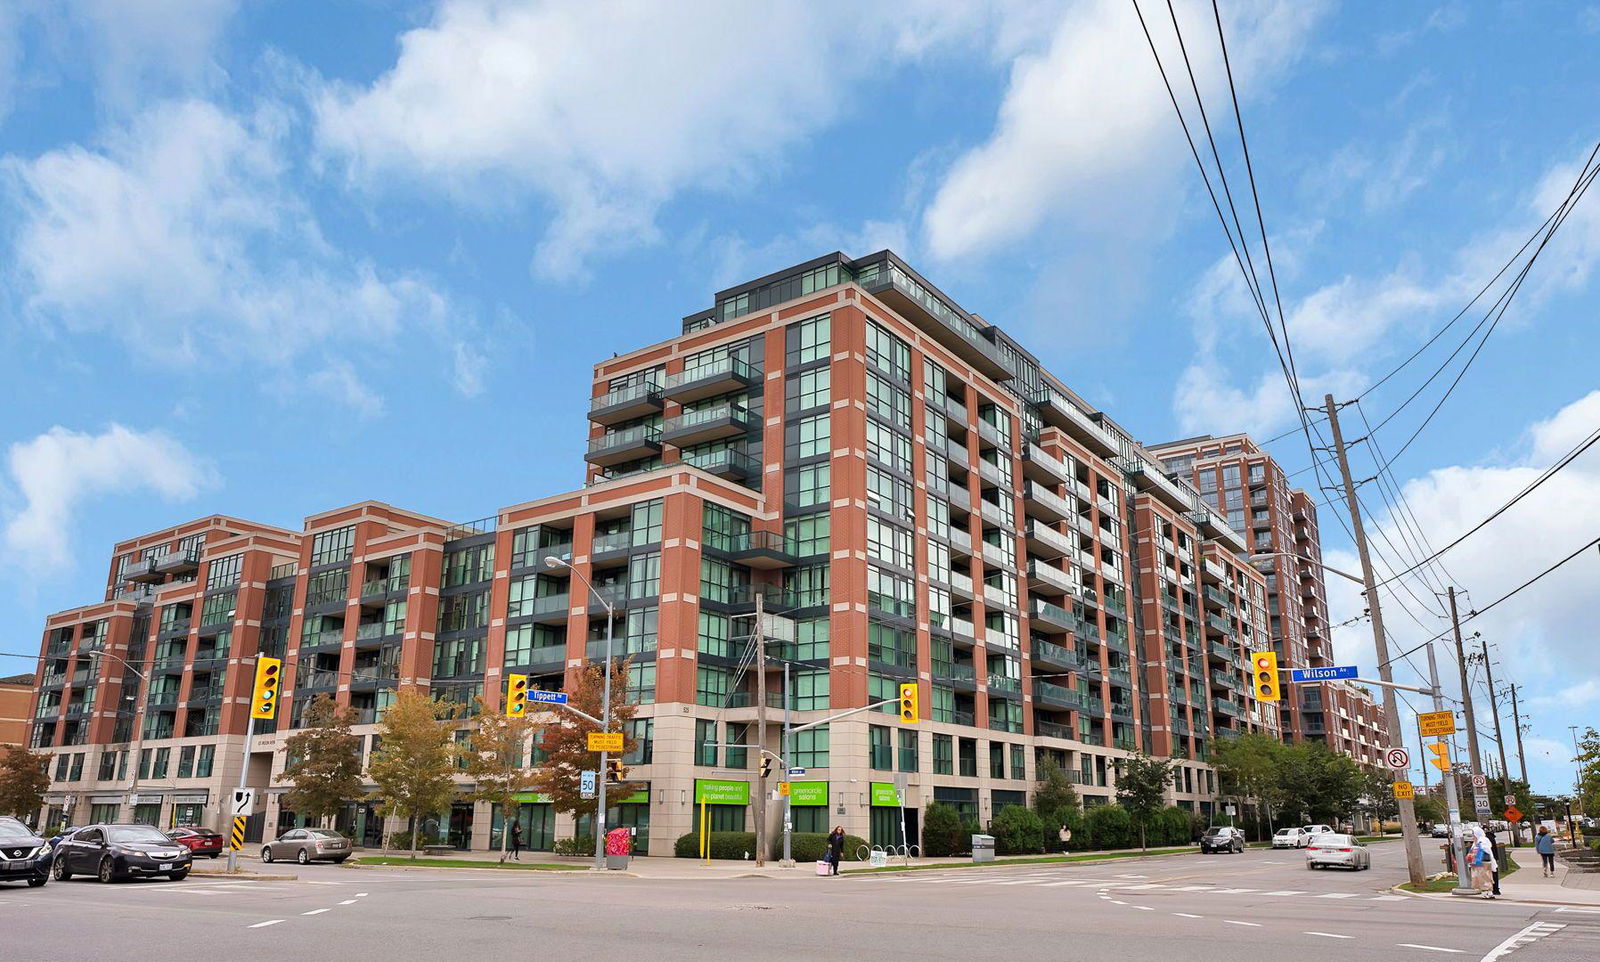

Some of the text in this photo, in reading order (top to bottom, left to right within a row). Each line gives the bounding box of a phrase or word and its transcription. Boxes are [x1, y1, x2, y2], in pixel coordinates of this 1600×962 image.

[1303, 669, 1337, 679] Wilson
[534, 691, 556, 701] Tippett
[582, 780, 593, 790] 50
